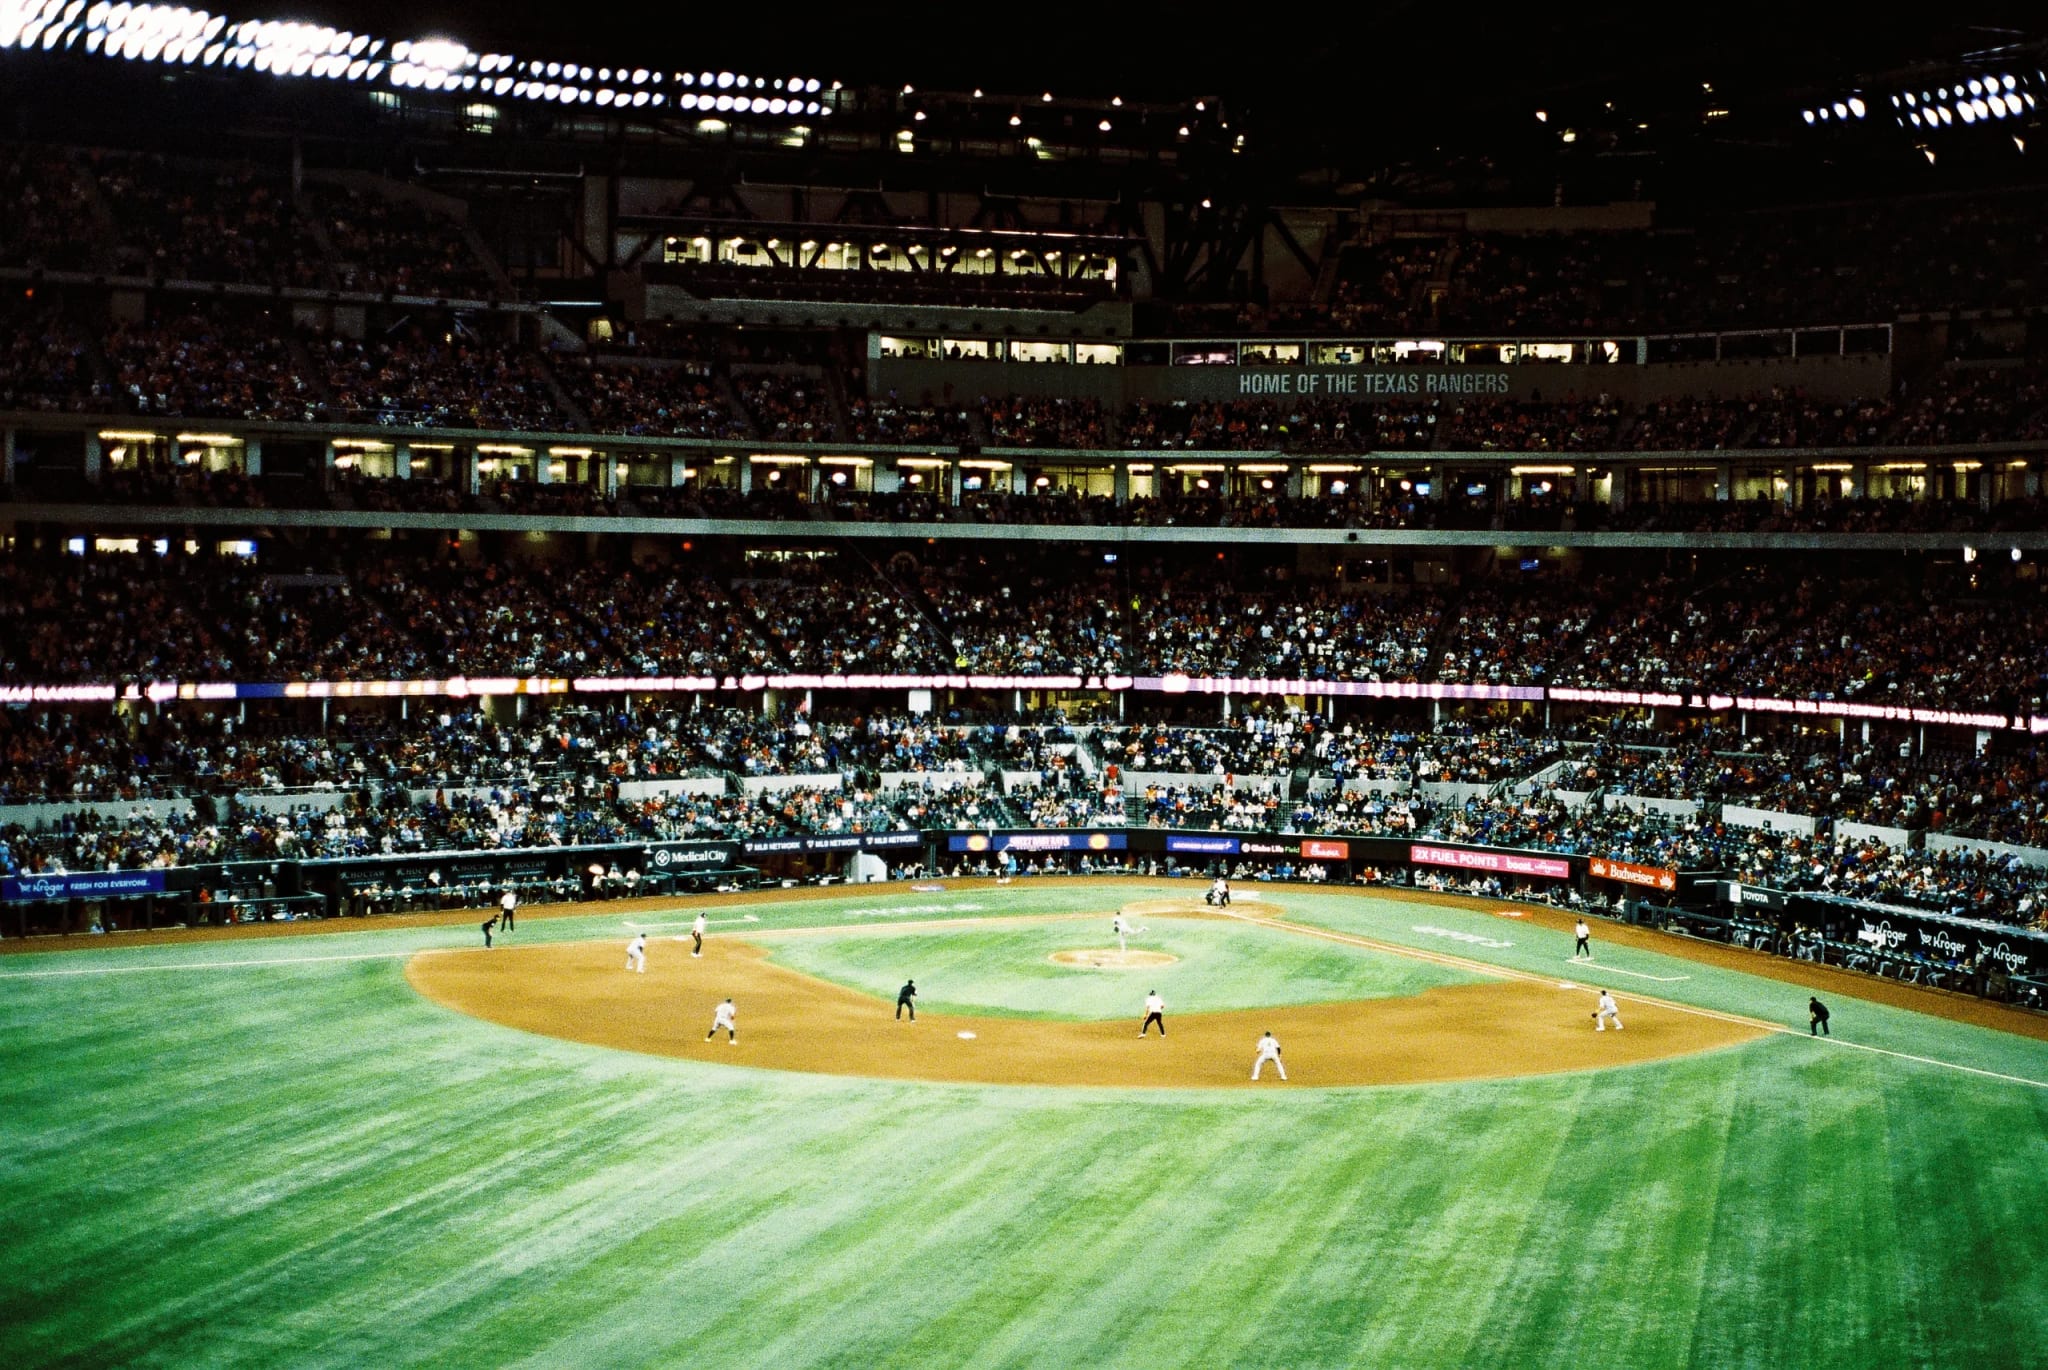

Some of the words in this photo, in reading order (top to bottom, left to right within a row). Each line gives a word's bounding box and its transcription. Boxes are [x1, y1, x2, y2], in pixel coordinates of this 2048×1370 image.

[1240, 374, 1290, 394] HOME
[1297, 374, 1319, 394] OF
[1325, 374, 1357, 394] THE
[1363, 374, 1419, 394] TEXAS
[1426, 374, 1509, 394] RANGERS
[1913, 709, 1949, 722] TEXAS
[1949, 712, 2007, 727] RANGERS
[769, 841, 800, 851] NETWORK
[829, 838, 860, 848] NETWORK
[888, 834, 918, 844] NETWORK
[671, 850, 708, 863] Medical
[708, 850, 728, 863] City
[1250, 844, 1271, 852] Globe
[1271, 844, 1284, 853] Life
[1414, 849, 1429, 860] 2X
[1431, 851, 1457, 863] FUEL
[1459, 854, 1498, 867] POINTS
[1609, 864, 1656, 885] Budweiser
[33, 879, 65, 897] Kroger
[70, 882, 92, 891] FRESH
[94, 881, 109, 889] FOR
[1741, 890, 1769, 904] TOYOTA
[1875, 920, 1908, 948] Kroger
[1932, 930, 1967, 957] Kroger
[1993, 942, 2029, 972] Kroger
